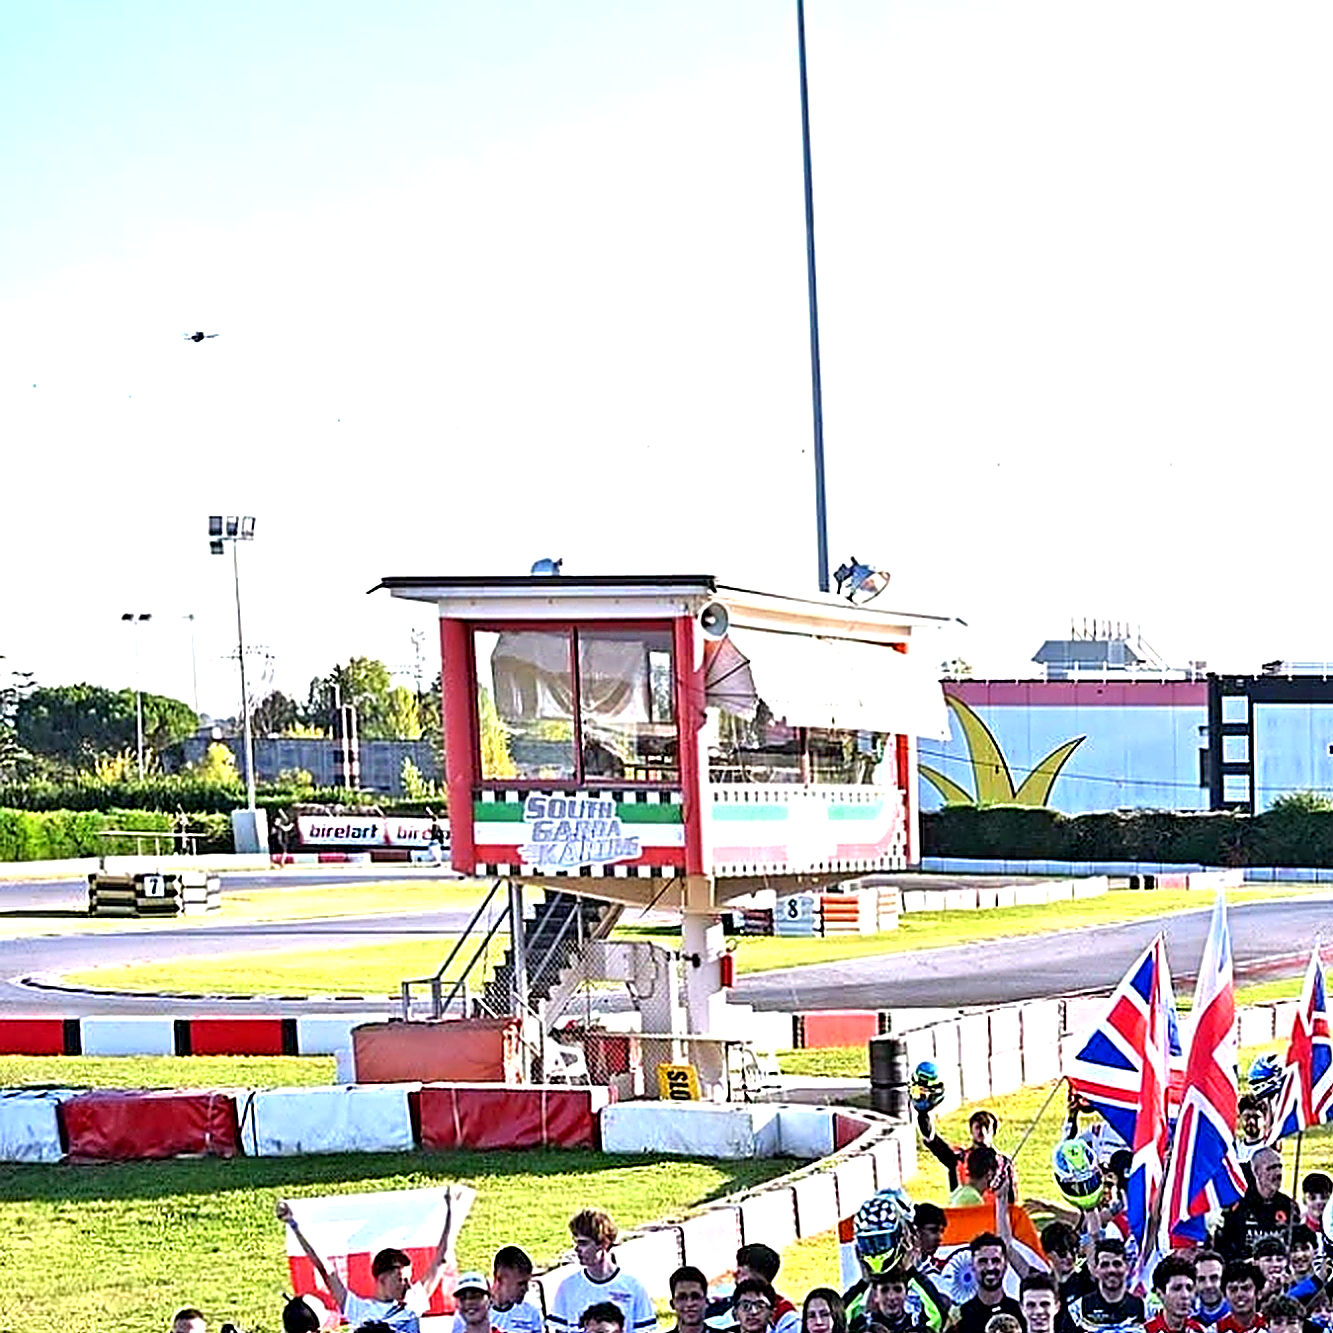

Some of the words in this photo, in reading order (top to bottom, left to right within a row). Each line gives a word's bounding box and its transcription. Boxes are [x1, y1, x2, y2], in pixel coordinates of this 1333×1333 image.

[526, 798, 613, 819] SOUTH
[309, 823, 378, 840] birelart
[531, 820, 622, 842] GARDA
[149, 878, 159, 894] 7
[788, 899, 799, 918] 8
